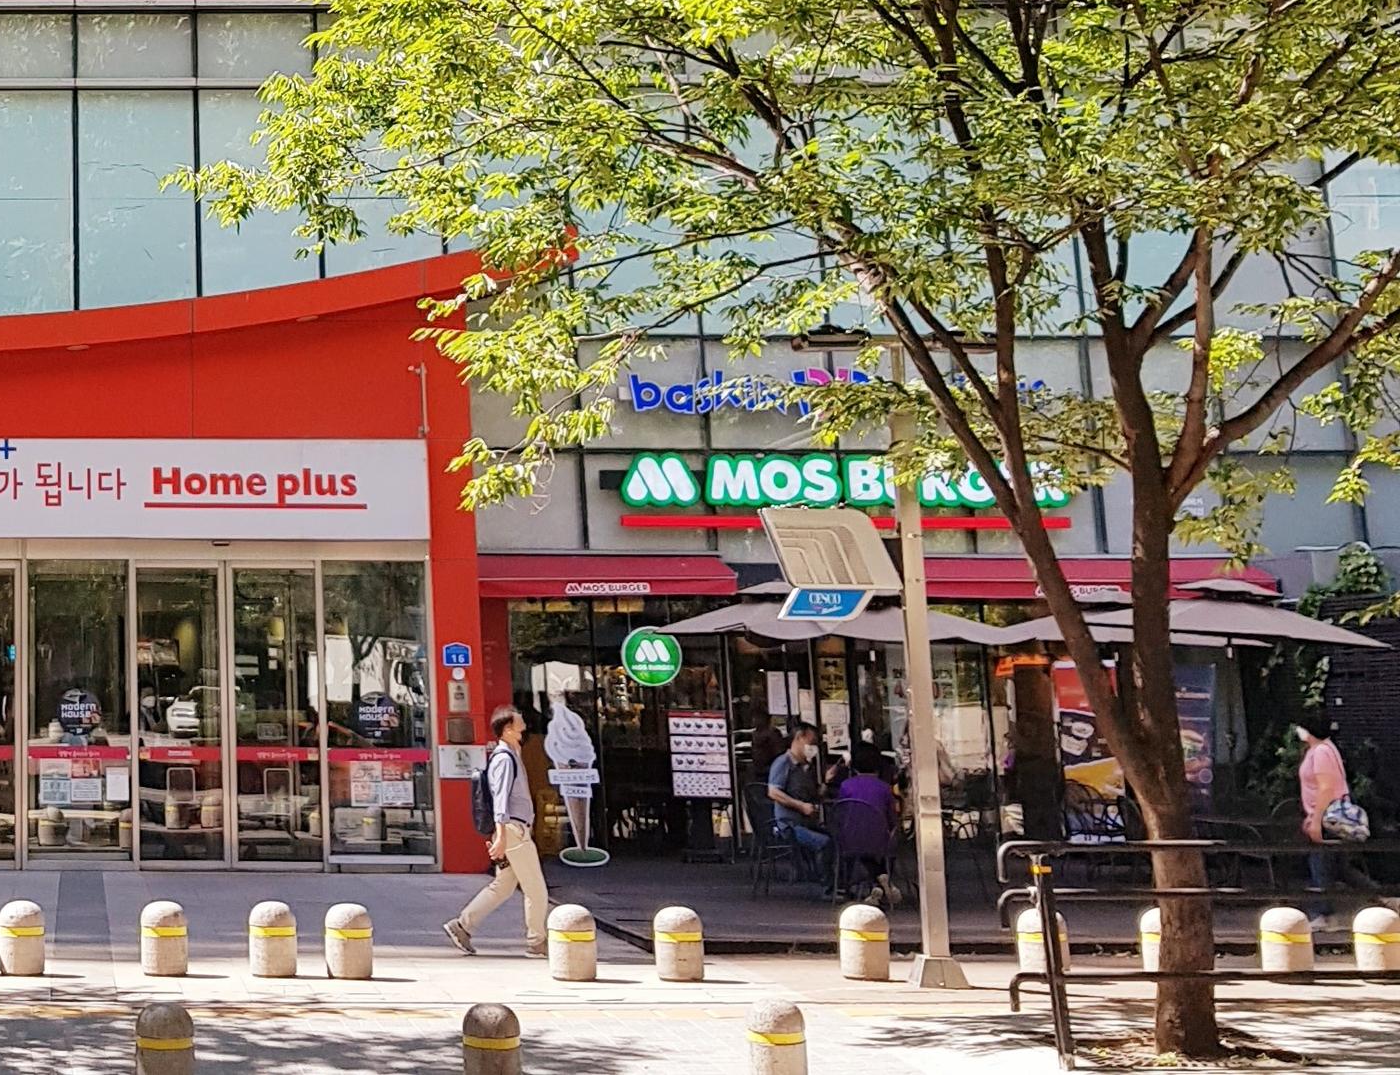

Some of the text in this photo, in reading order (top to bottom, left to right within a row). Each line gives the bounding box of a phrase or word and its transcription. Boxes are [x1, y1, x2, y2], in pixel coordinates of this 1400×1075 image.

[34, 462, 127, 507] 됩니다
[152, 467, 268, 496] Home
[277, 467, 358, 503] plus
[711, 458, 839, 502] MOS
[849, 458, 1064, 503] BRGR
[582, 583, 648, 592] MOS BURGER
[451, 654, 465, 664] 16
[60, 702, 97, 711] Modern
[359, 704, 395, 714] Modern
[60, 711, 92, 719] House
[359, 713, 390, 721] House
